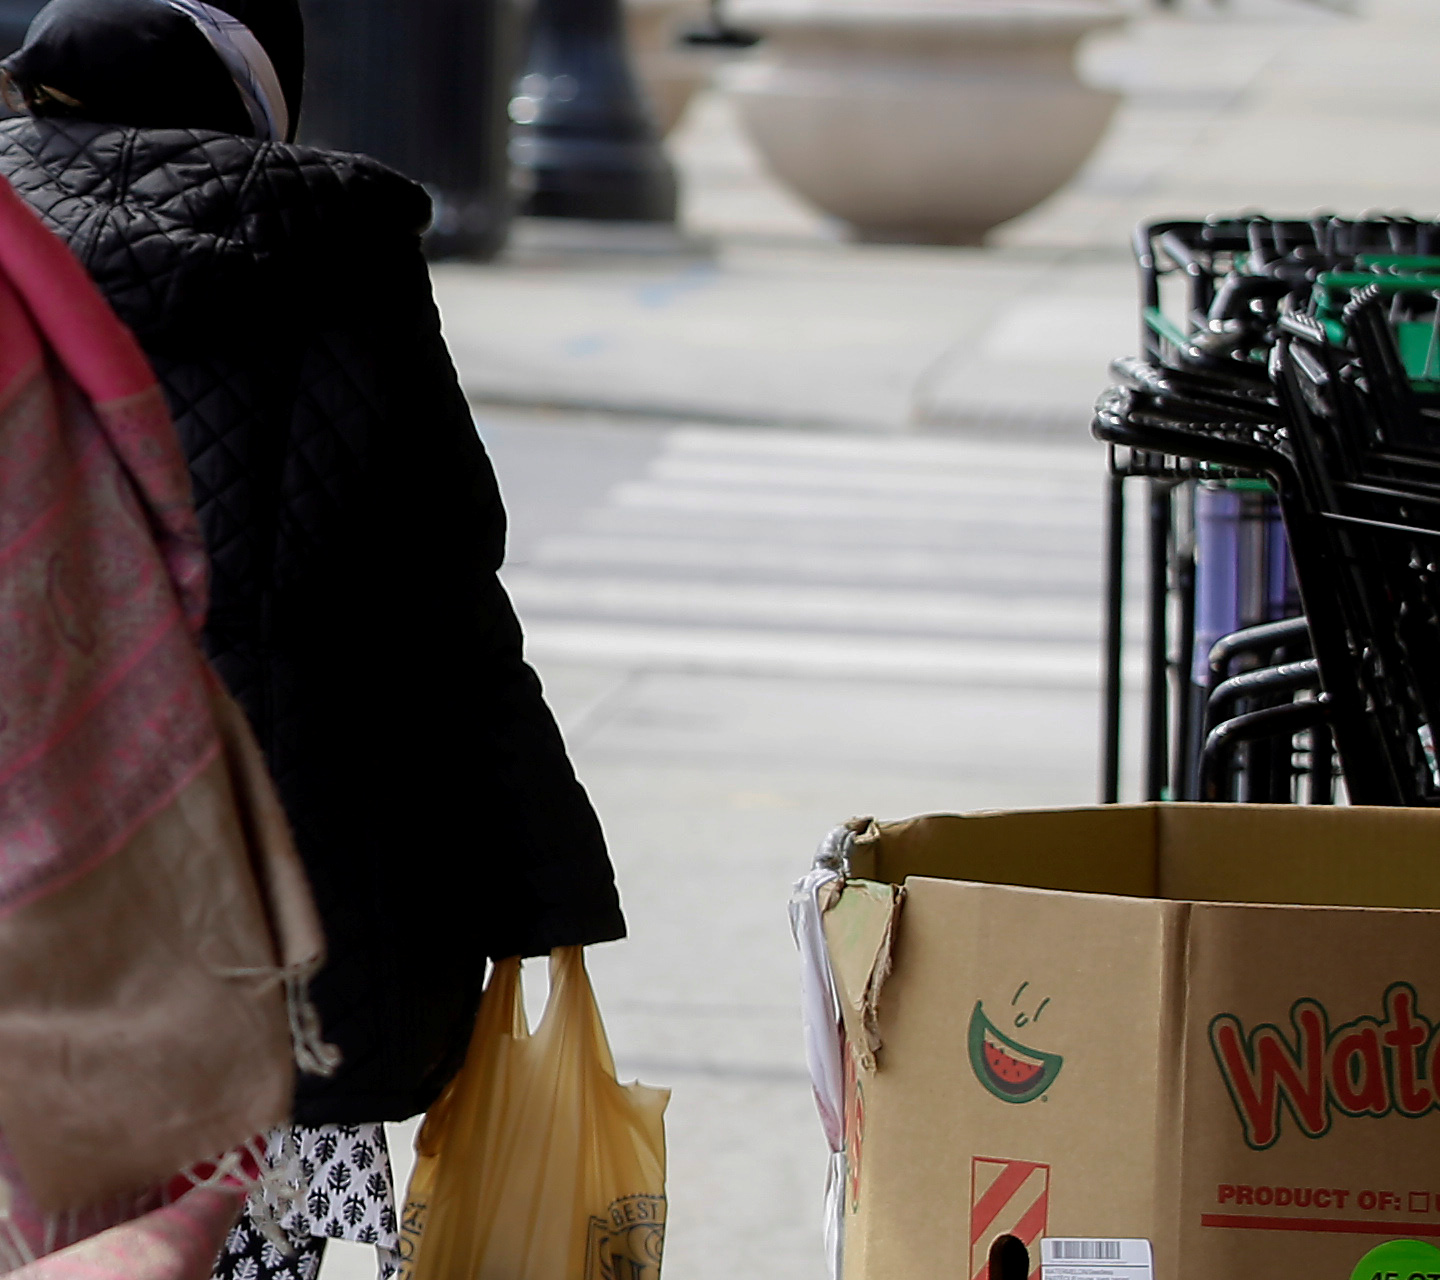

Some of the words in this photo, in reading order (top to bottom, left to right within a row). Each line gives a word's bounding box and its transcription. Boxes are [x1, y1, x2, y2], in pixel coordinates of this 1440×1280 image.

[1217, 1183, 1349, 1209] PRODUCT
[1356, 1189, 1402, 1211] OF:
[610, 1202, 658, 1227] BEST
